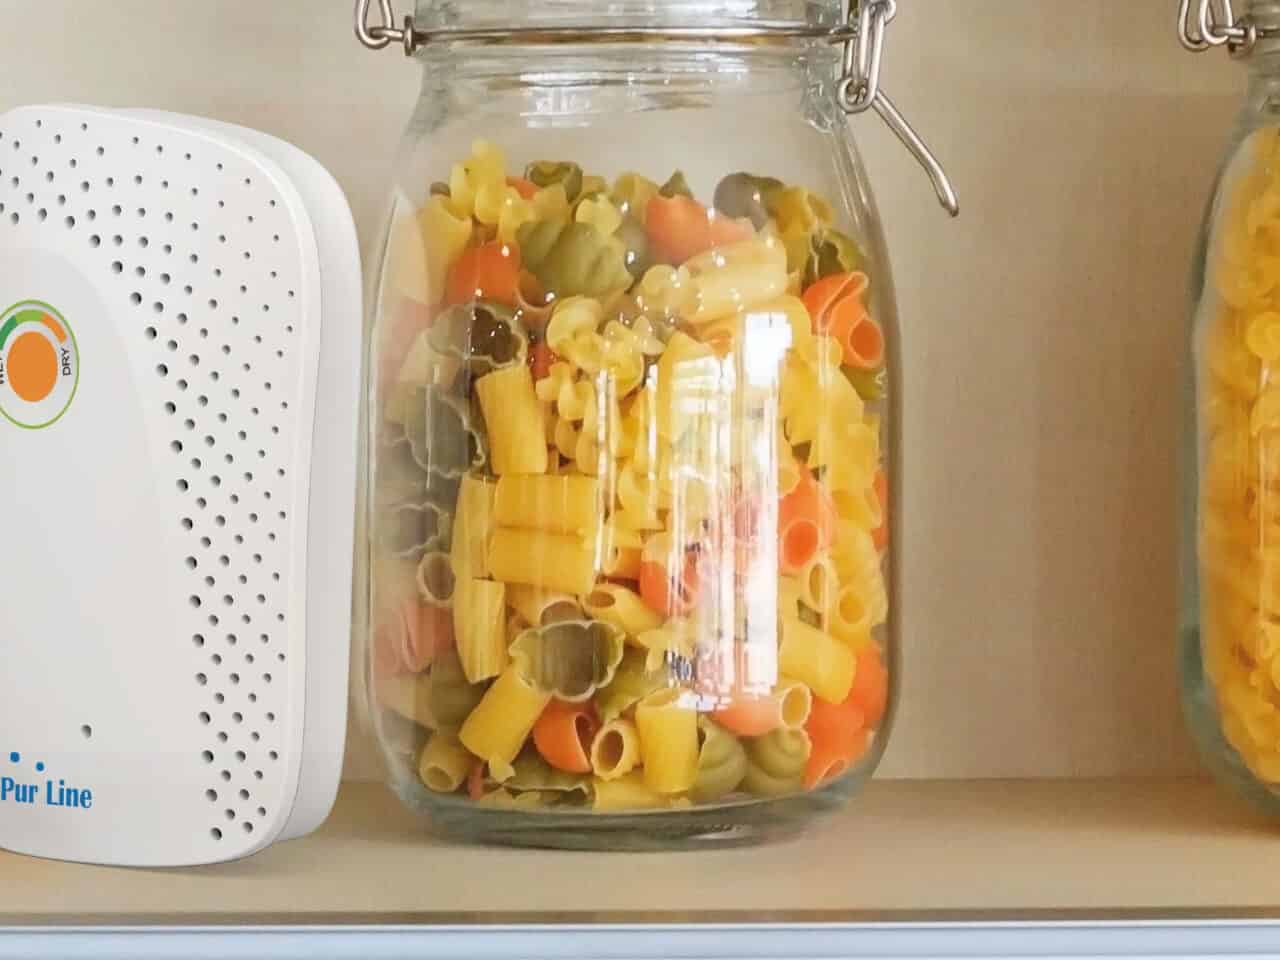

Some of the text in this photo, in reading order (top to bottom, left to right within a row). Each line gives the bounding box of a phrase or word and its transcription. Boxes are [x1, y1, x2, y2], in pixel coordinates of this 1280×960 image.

[61, 347, 71, 376] DRY
[1, 776, 93, 809] Pur Line
